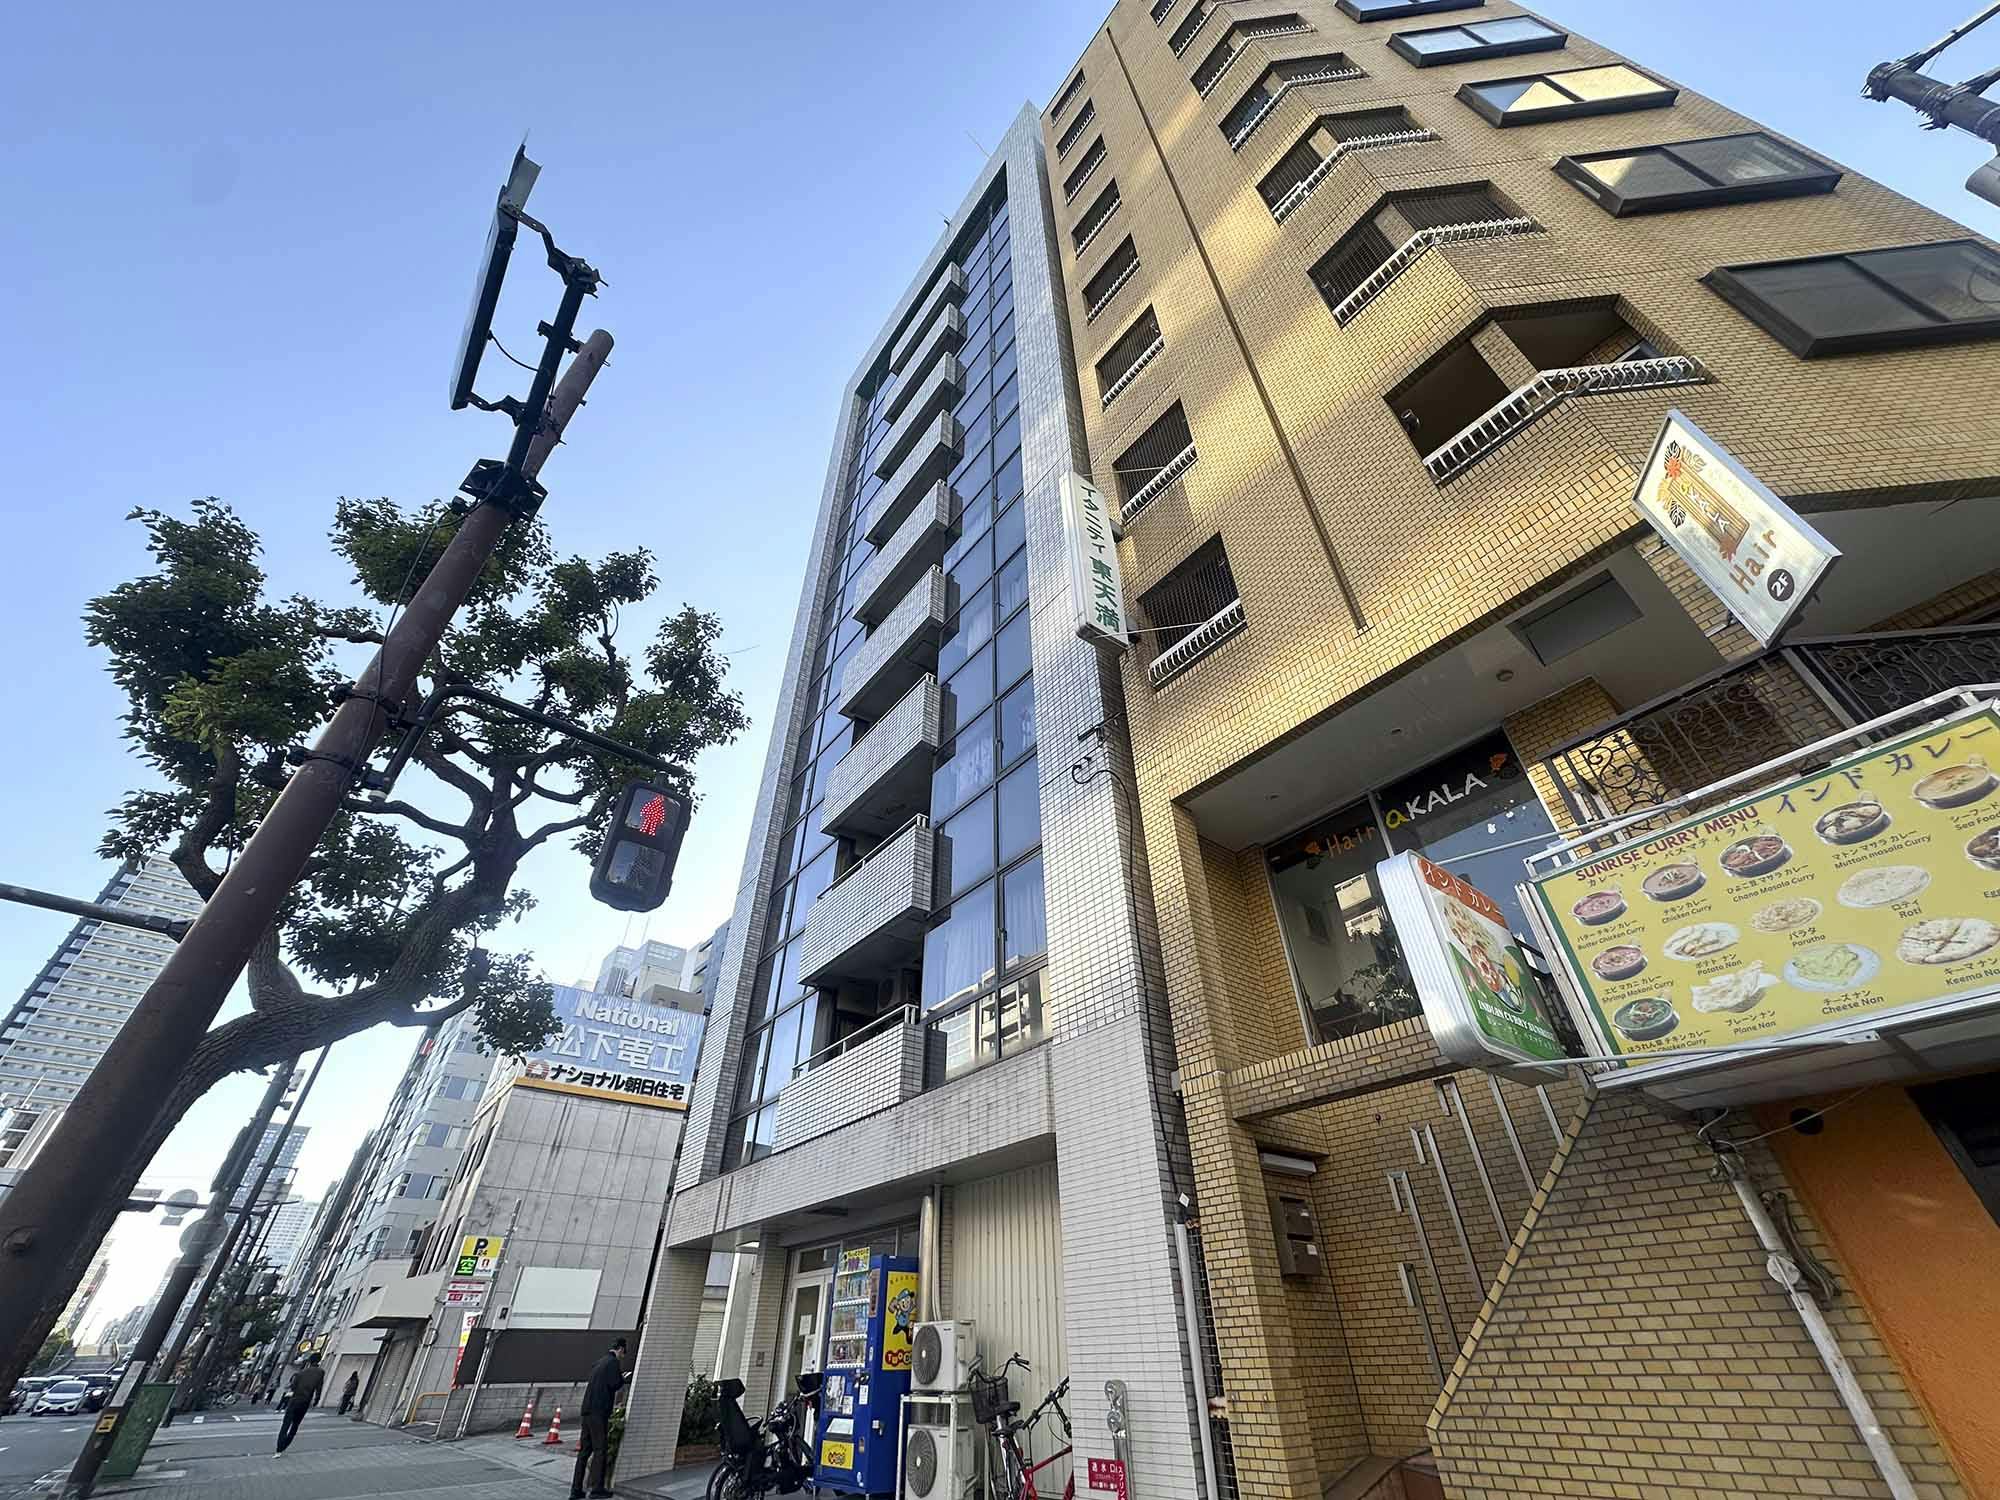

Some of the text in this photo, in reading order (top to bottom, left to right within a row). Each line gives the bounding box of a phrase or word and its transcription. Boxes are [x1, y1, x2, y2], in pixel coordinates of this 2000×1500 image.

[1729, 529, 1777, 594] Hair
[1771, 571, 1789, 598] 2F
[1777, 727, 1992, 813] インド カレー
[1954, 821, 1975, 831] Sea
[1326, 824, 1376, 858] Hair
[1575, 806, 1759, 882] SUNRISE CURRY MENU
[1834, 833, 1932, 870] Mutton masala Curry
[1732, 872, 1815, 903] Chana Masala Curry
[1661, 904, 1713, 923] Chicken Curry
[1898, 907, 1923, 919] Roti
[1598, 931, 1626, 944] Chicken
[1626, 925, 1646, 936] Curry
[1697, 959, 1743, 976] Potato Nan
[1654, 980, 1675, 990] Curry
[1945, 972, 1983, 985] Keema
[1822, 995, 1885, 1015] Cheese Nan
[576, 998, 680, 1036] National
[1758, 1020, 1777, 1030] Nan
[546, 1024, 685, 1076] 松下電工
[549, 1063, 685, 1101] ナショナル朝日住宅
[473, 1237, 489, 1256] P
[456, 1256, 476, 1275] 空
